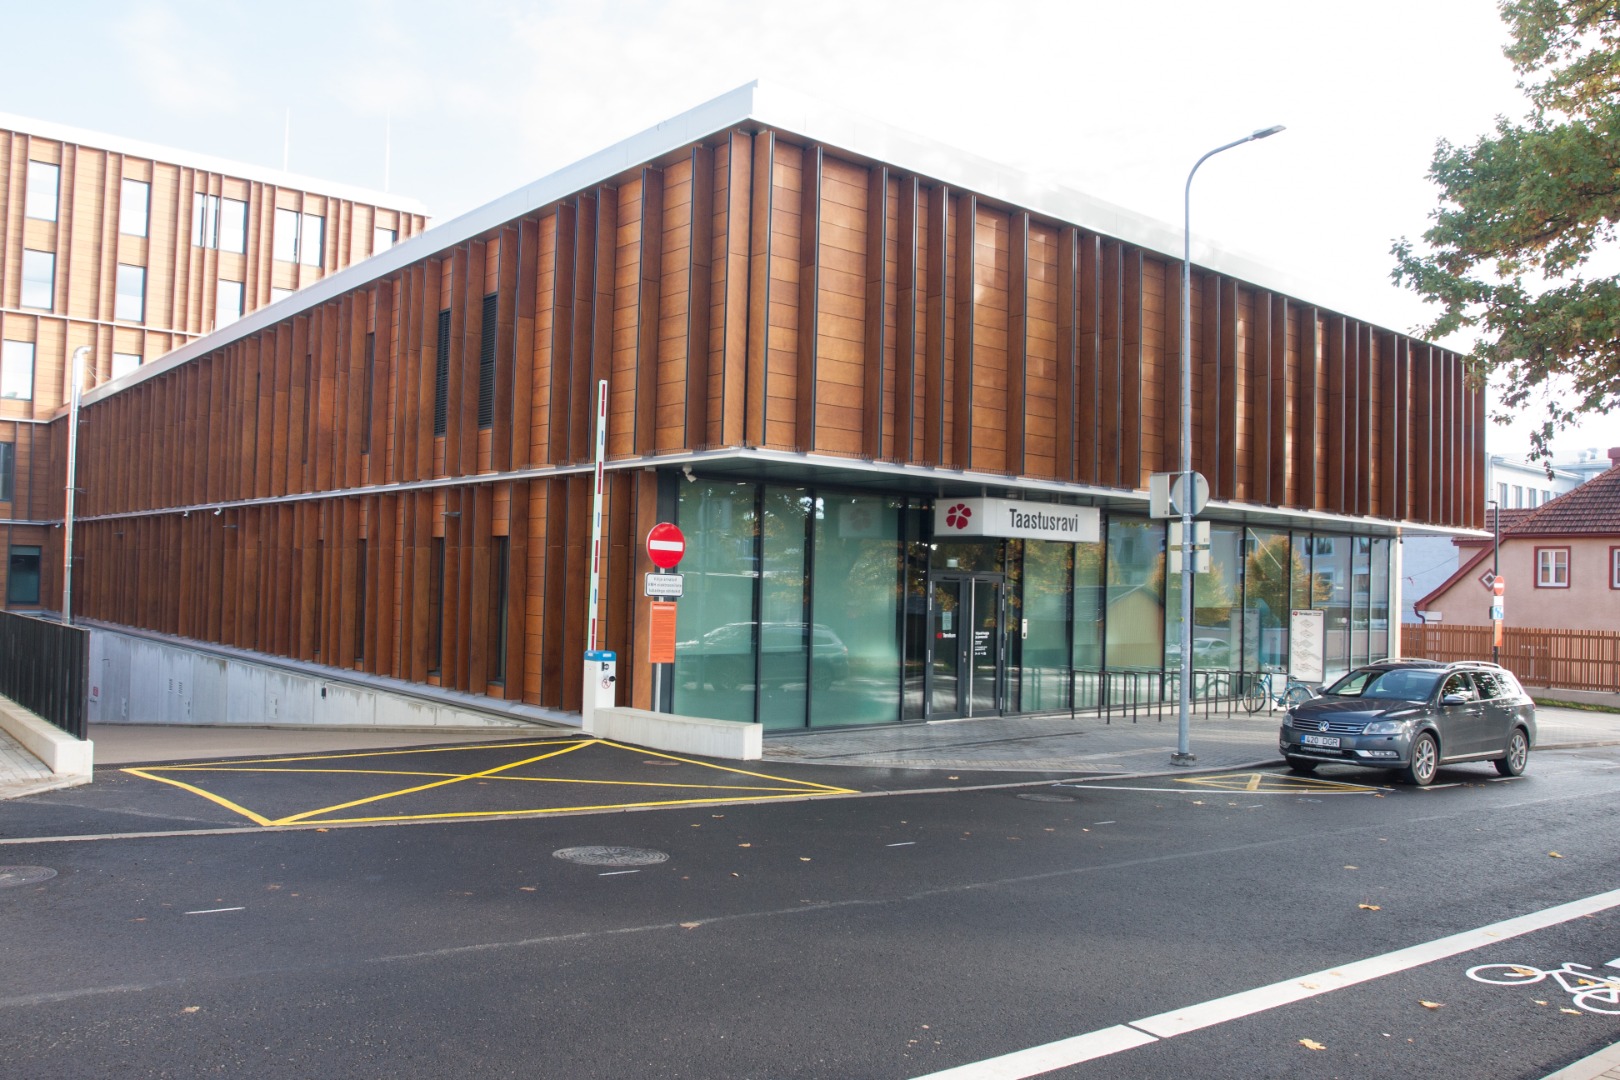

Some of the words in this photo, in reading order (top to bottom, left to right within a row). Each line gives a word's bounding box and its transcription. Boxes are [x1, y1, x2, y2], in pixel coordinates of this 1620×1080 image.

[1009, 508, 1079, 532] Taastusravi
[1306, 736, 1319, 744] 420
[1322, 737, 1338, 746] DGR
